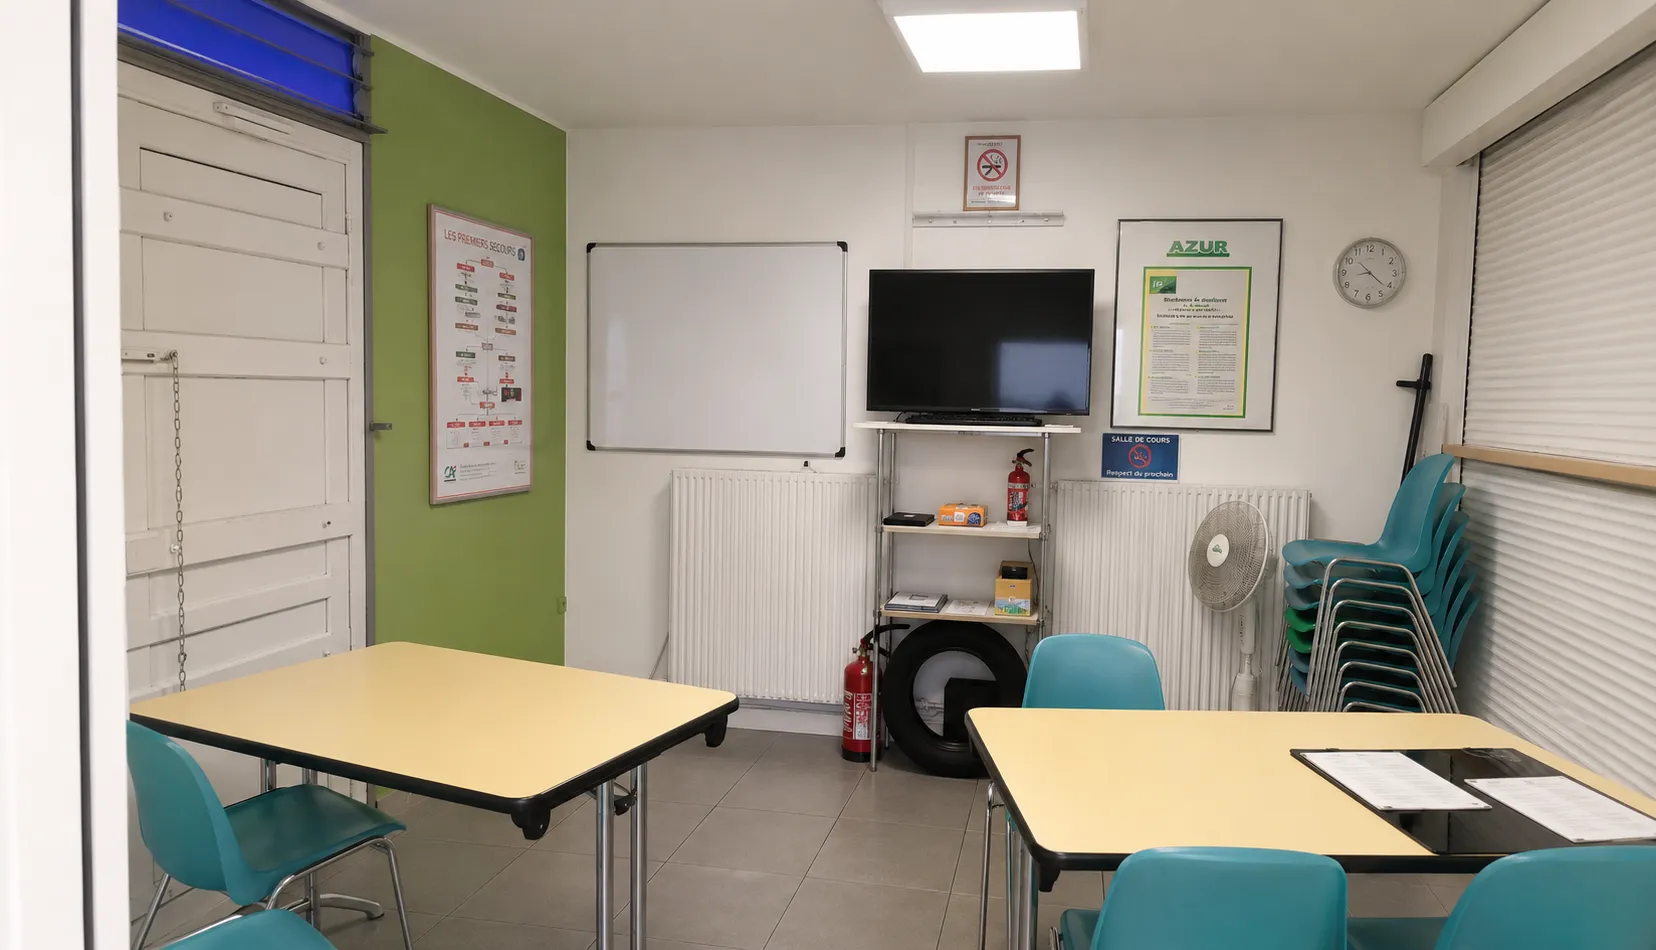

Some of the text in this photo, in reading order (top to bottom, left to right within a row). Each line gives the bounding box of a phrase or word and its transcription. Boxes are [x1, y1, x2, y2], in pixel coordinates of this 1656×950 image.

[444, 229, 456, 242] LES
[1169, 240, 1228, 253] AZUR
[1366, 245, 1375, 253] 12
[1355, 248, 1361, 256] 11
[1345, 257, 1354, 265] 10
[1389, 257, 1394, 265] 2
[1341, 269, 1347, 277] 9
[1344, 281, 1349, 289] 8
[1354, 289, 1359, 298] 7
[1365, 293, 1371, 301] 6
[1111, 435, 1133, 443] SALLE
[1146, 436, 1170, 444] COURS
[1106, 469, 1132, 477] Respect
[1144, 470, 1174, 478] prochain
